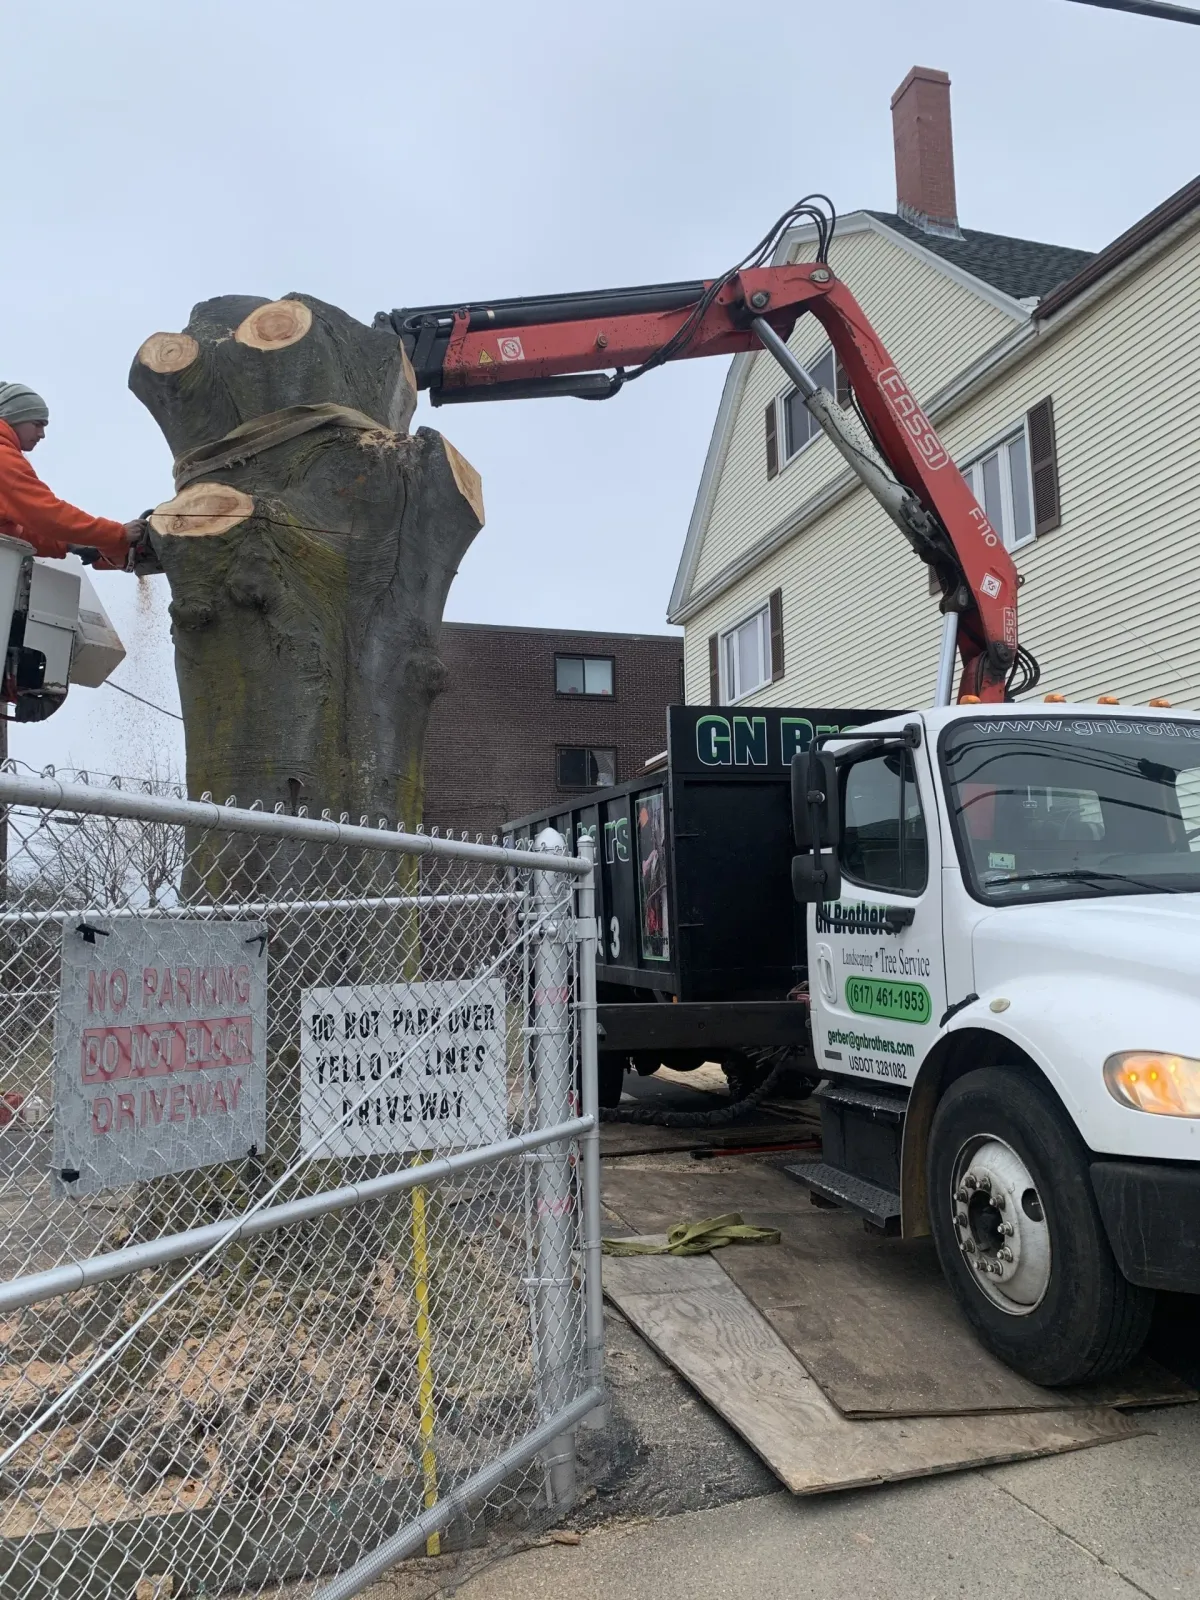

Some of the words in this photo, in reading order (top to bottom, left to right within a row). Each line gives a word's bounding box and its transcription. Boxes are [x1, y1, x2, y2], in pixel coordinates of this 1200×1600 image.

[883, 374, 944, 463] FASSI
[968, 507, 998, 547] F110
[1005, 610, 1015, 648] FASSI
[696, 714, 769, 766] GN
[842, 948, 873, 972] Landscaping
[880, 947, 897, 974] Tree
[899, 948, 930, 977] Service
[87, 968, 128, 1014] NO
[142, 965, 250, 1010] PARKING
[851, 984, 873, 1009] (617)
[876, 986, 924, 1012] 461-1953
[313, 1013, 335, 1042] DO
[345, 1010, 381, 1040] NOT
[393, 1007, 442, 1037] PARK
[448, 1004, 496, 1035] OVER
[828, 1029, 915, 1057] gerber@gnbrothers.com
[84, 1034, 120, 1077] DO
[131, 1029, 177, 1071] NOT
[185, 1024, 251, 1065] BLOCK
[316, 1052, 405, 1085] YELLOW
[425, 1045, 486, 1077] LINES
[848, 1054, 874, 1074] USDOT
[875, 1059, 907, 1080] 3281082
[91, 1075, 243, 1137] DRIVEWAY
